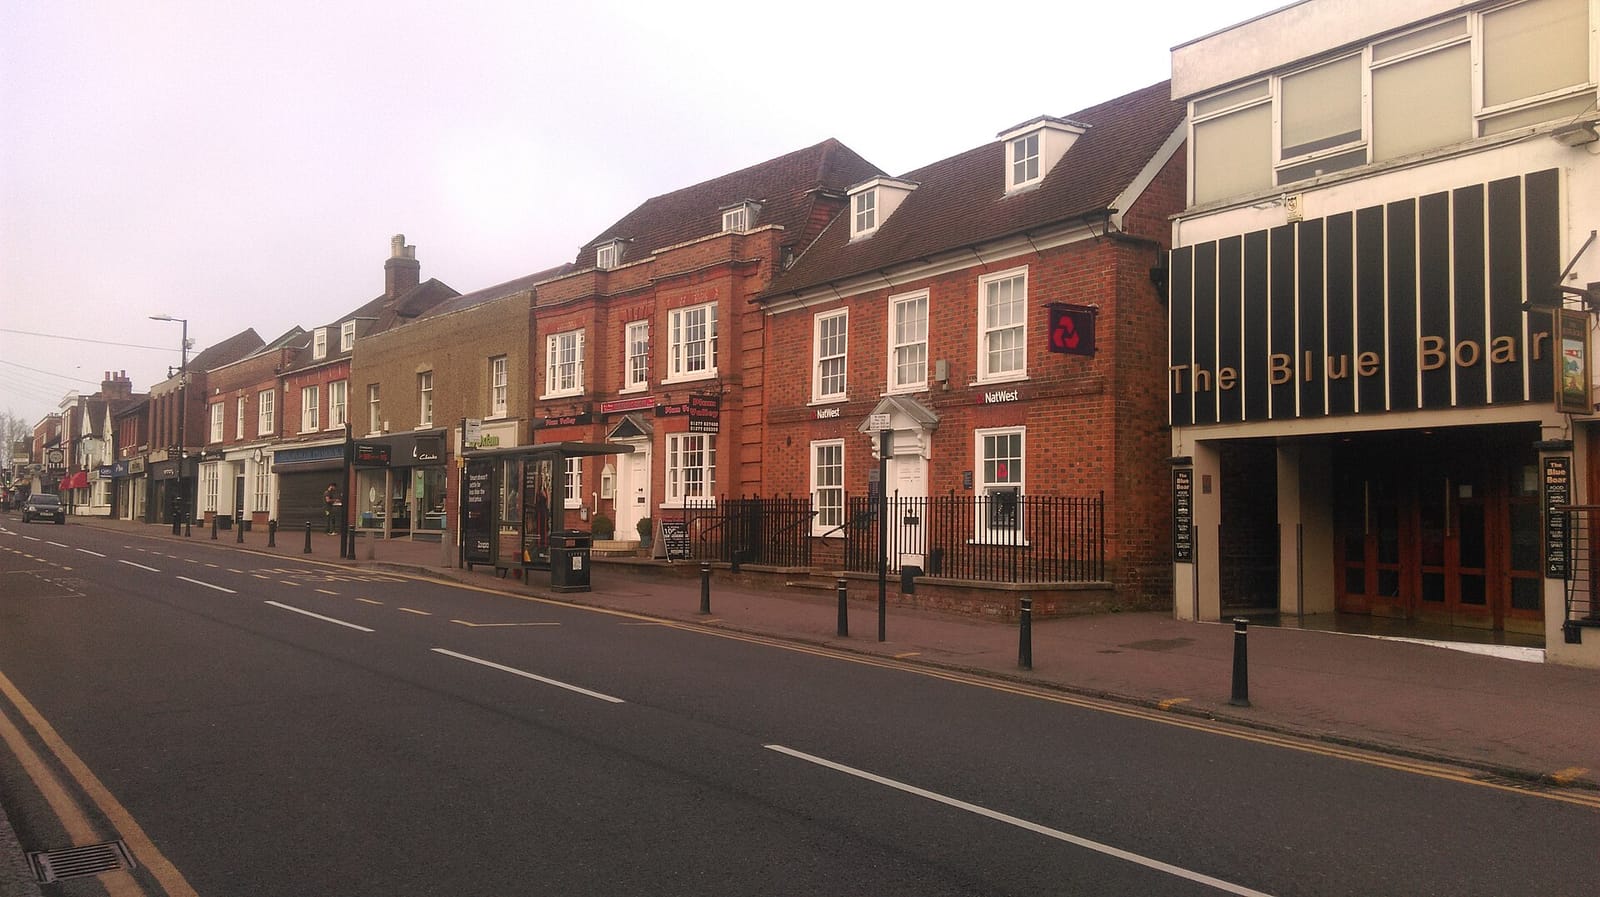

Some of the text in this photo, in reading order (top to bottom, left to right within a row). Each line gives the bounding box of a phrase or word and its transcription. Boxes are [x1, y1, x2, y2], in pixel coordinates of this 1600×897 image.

[1168, 331, 1549, 394] The Blue Boar
[985, 390, 1018, 404] NatWest
[817, 408, 840, 419] NatWest
[1546, 468, 1566, 476] Blue
[1546, 476, 1567, 484] Boar
